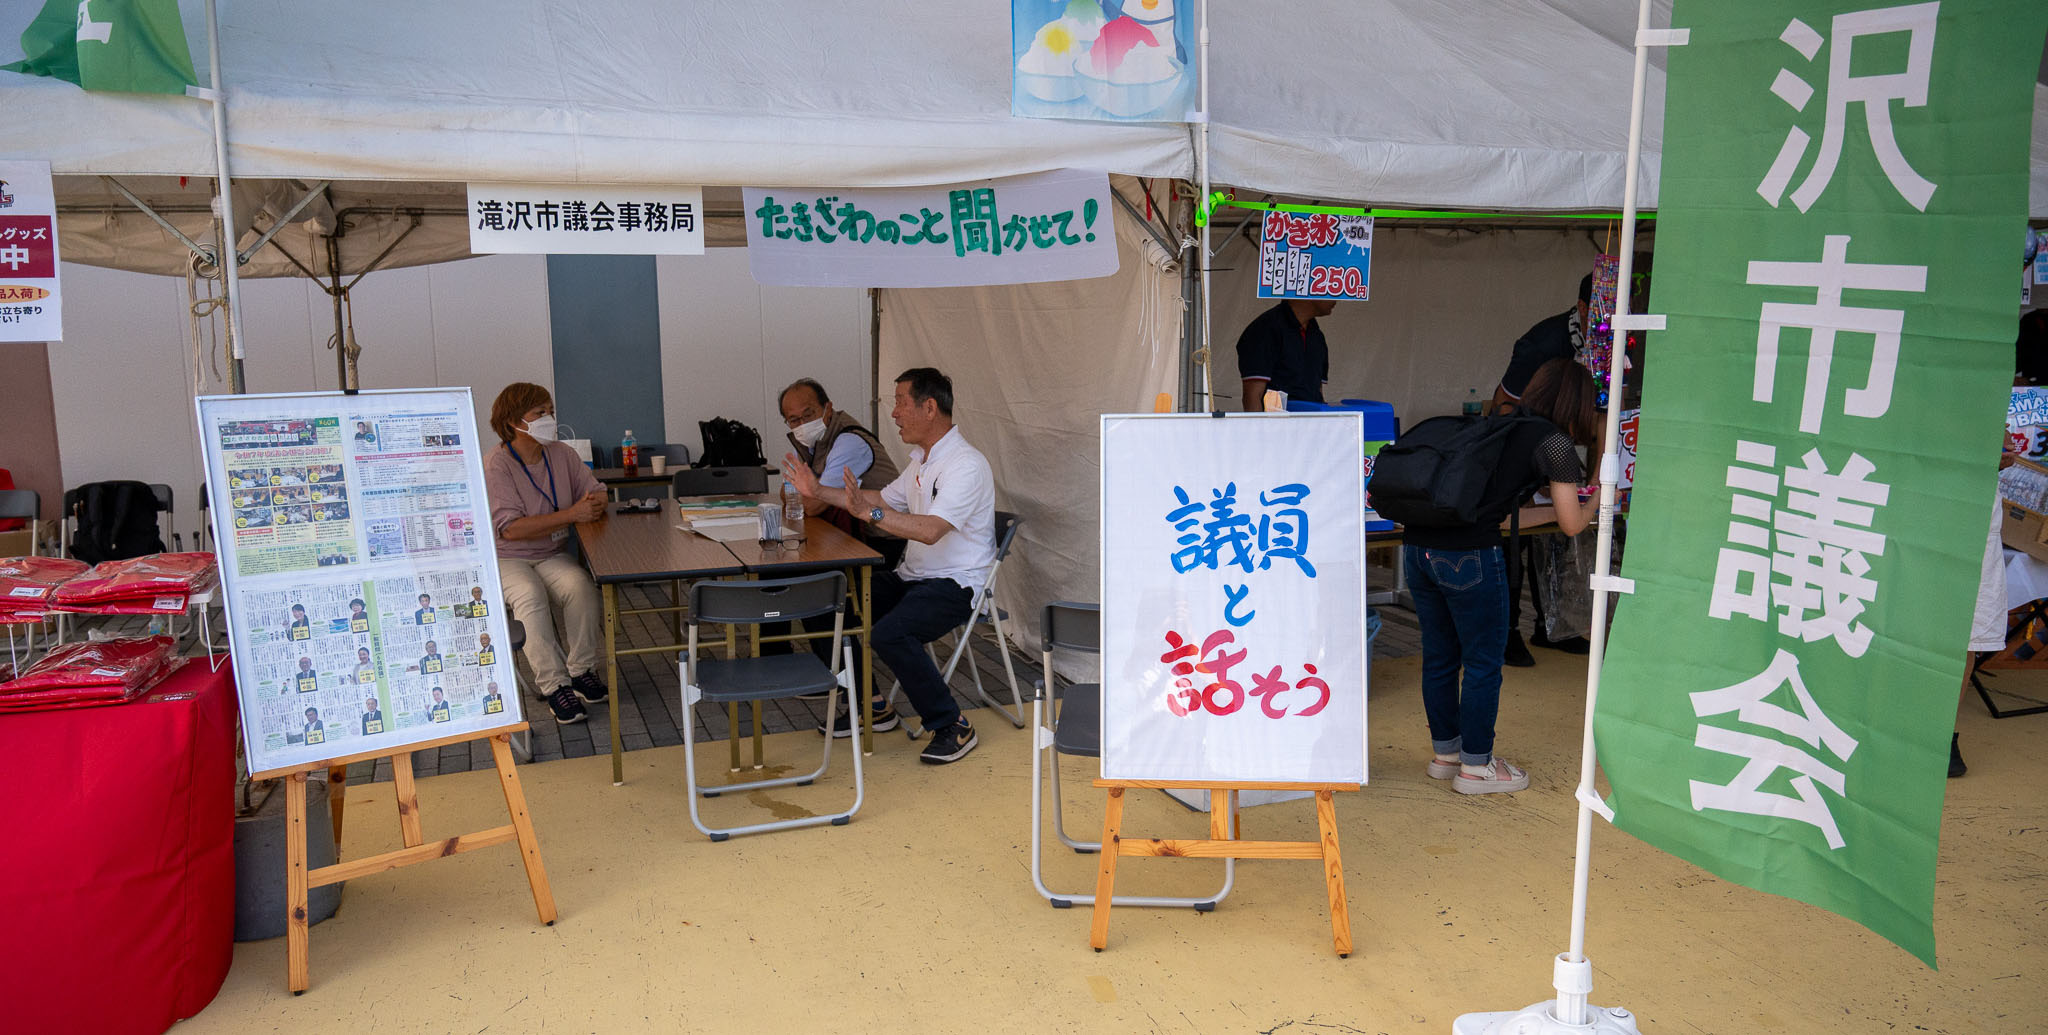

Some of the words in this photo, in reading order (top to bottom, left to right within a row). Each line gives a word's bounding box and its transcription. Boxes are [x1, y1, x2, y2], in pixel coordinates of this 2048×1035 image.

[0, 227, 47, 240] グッズ
[476, 199, 695, 233] 滝沢市議会事務局
[755, 187, 1098, 257] たきざわのこと聞かせて！
[1265, 211, 1340, 248] かき氷
[1, 244, 30, 271] 中
[1264, 246, 1274, 282] いちご
[1274, 256, 1285, 291] メロン
[1288, 250, 1298, 287] グレープ
[1310, 266, 1368, 298] 250円
[1689, 1, 1940, 850] 沢市議会
[1165, 482, 1317, 578] 議員
[1223, 584, 1256, 627] と
[1160, 629, 1332, 720] 話そう
